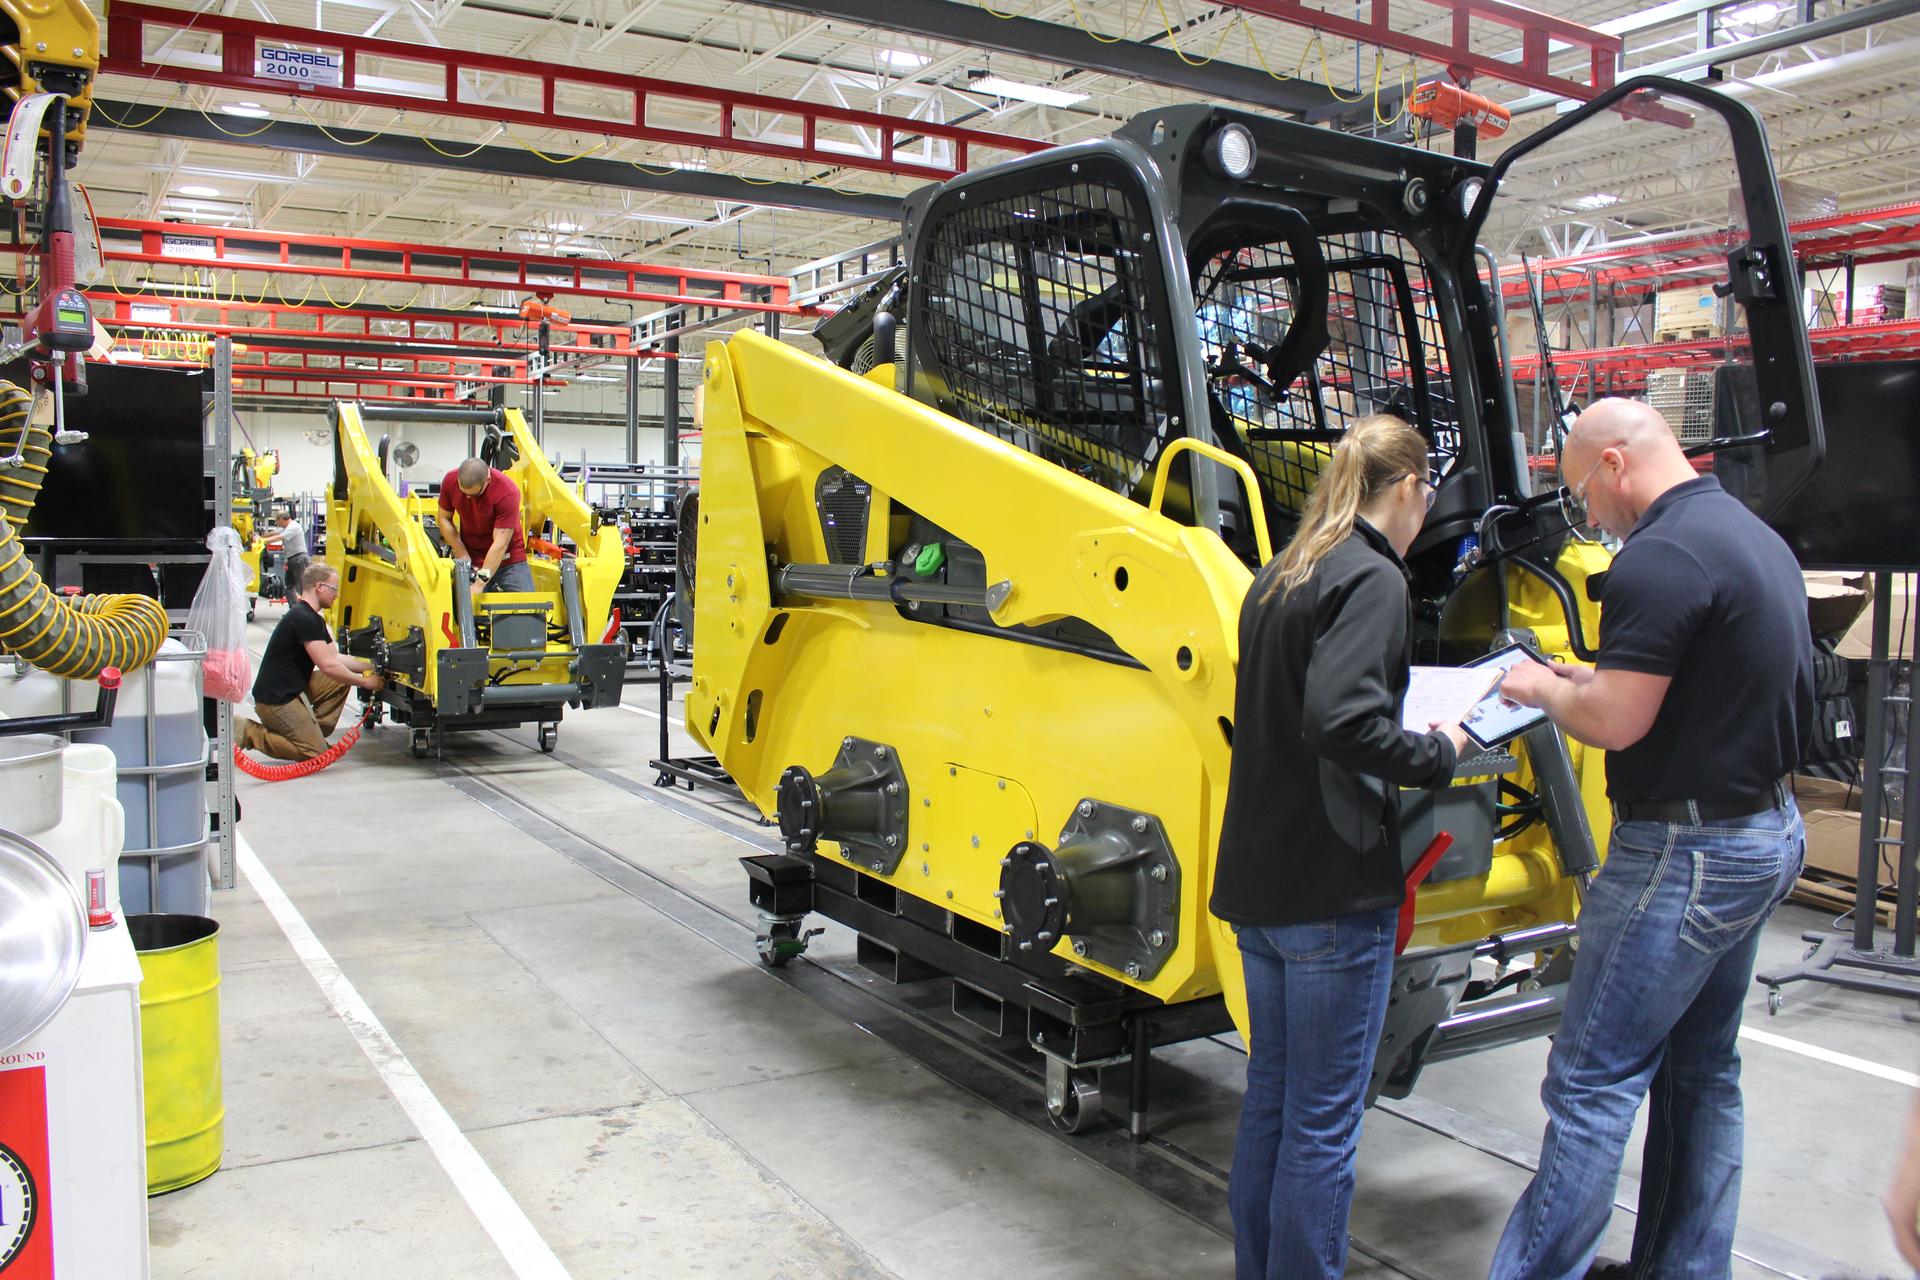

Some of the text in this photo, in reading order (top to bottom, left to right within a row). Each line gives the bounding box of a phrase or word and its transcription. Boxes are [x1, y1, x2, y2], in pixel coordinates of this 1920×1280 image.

[261, 48, 339, 68] GORBEL
[266, 63, 309, 77] 2000
[165, 237, 215, 247] GORBEL
[168, 246, 195, 254] 2000
